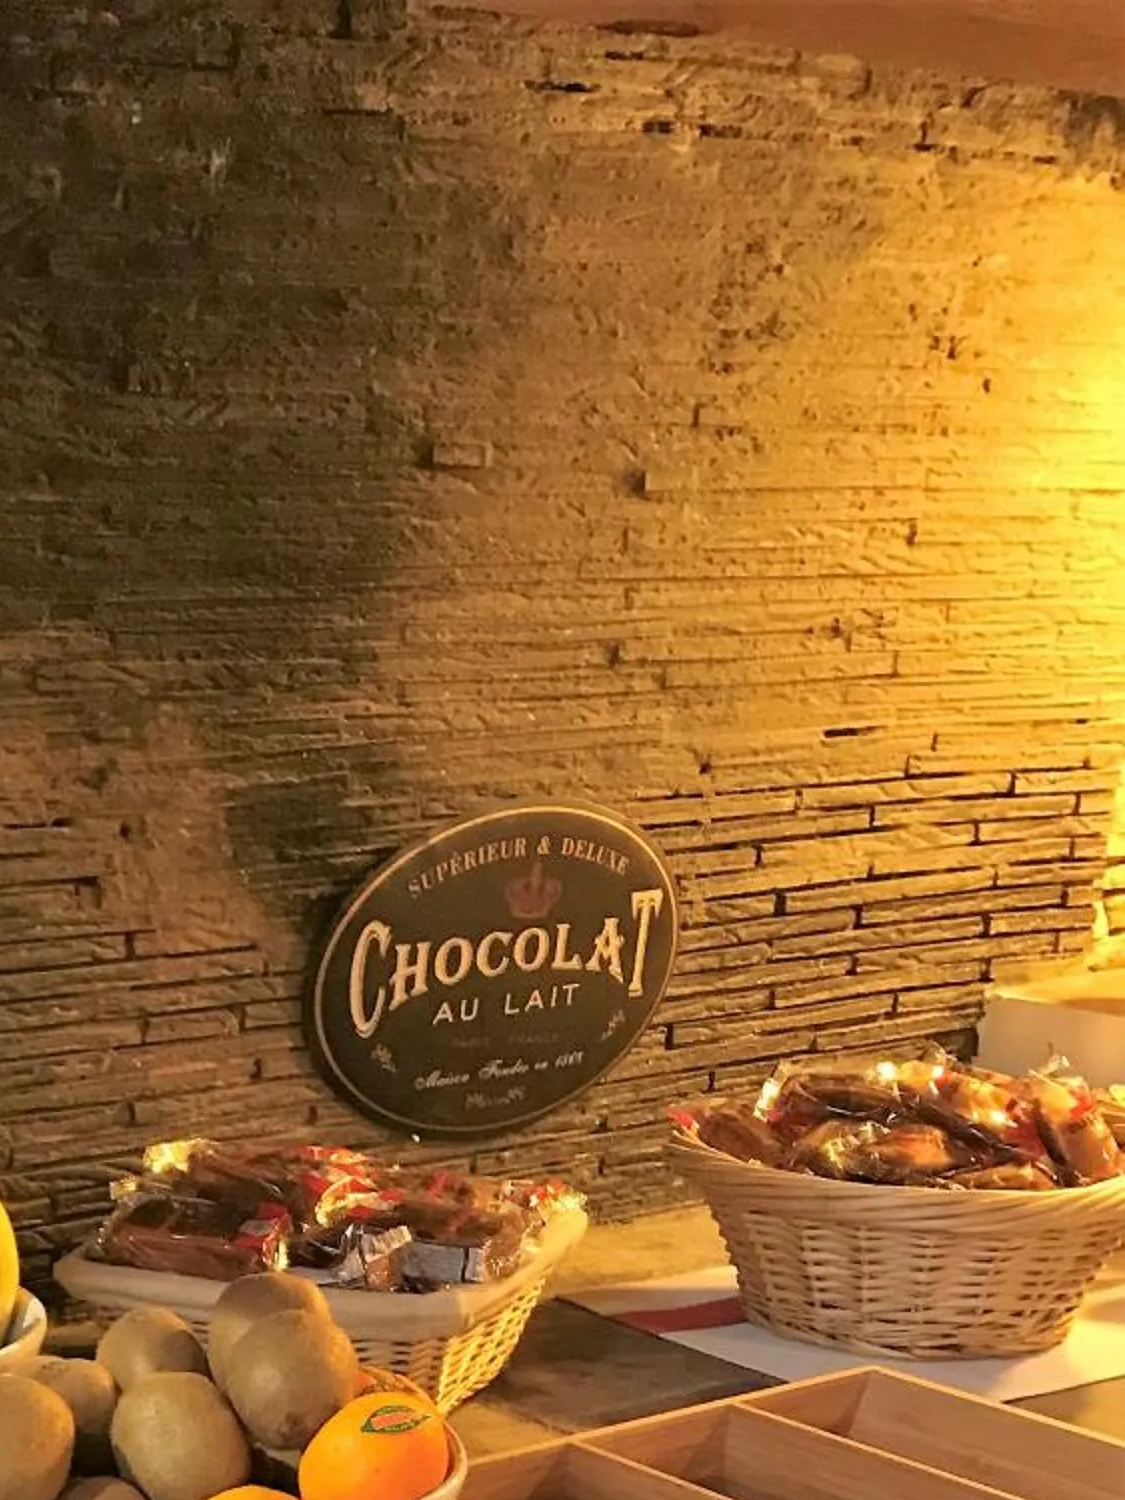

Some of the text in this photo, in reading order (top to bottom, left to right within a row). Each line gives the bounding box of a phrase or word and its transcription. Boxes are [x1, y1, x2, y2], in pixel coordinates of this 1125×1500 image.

[536, 835, 552, 856] &
[561, 837, 631, 876] DELUXE
[348, 888, 664, 1040] CHOCOLAT
[431, 982, 582, 1027] AU LAIT
